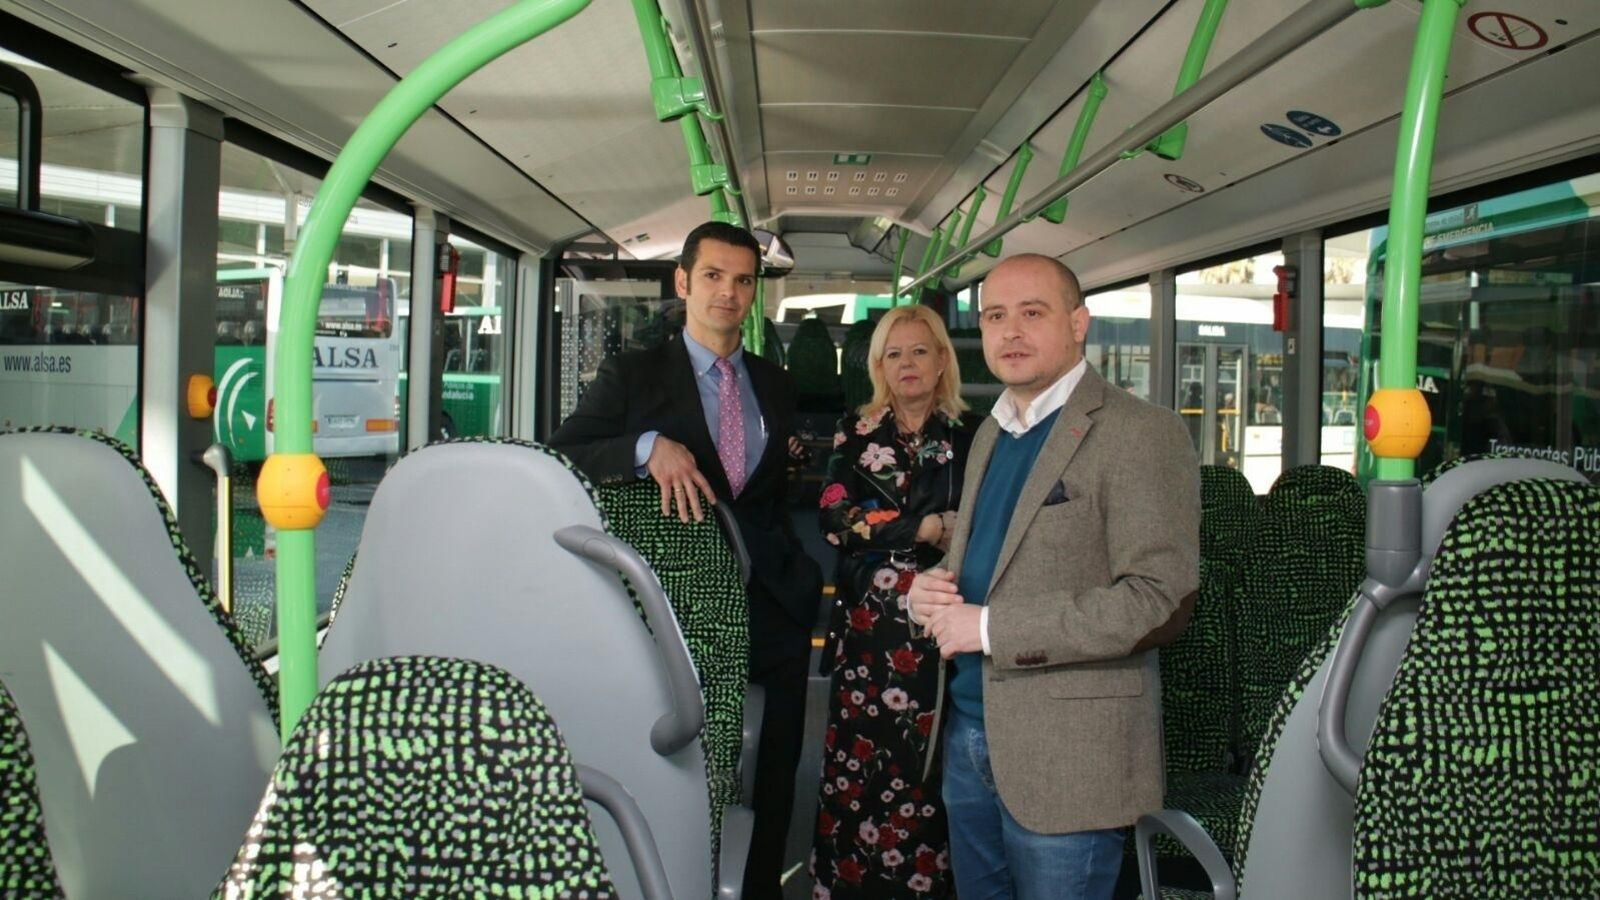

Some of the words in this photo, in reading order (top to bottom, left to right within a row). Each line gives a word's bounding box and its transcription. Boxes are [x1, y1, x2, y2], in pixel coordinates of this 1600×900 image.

[1437, 222, 1494, 240] EMERGENCIA
[0, 291, 28, 310] LSA
[4, 352, 71, 373] www.alsa.es
